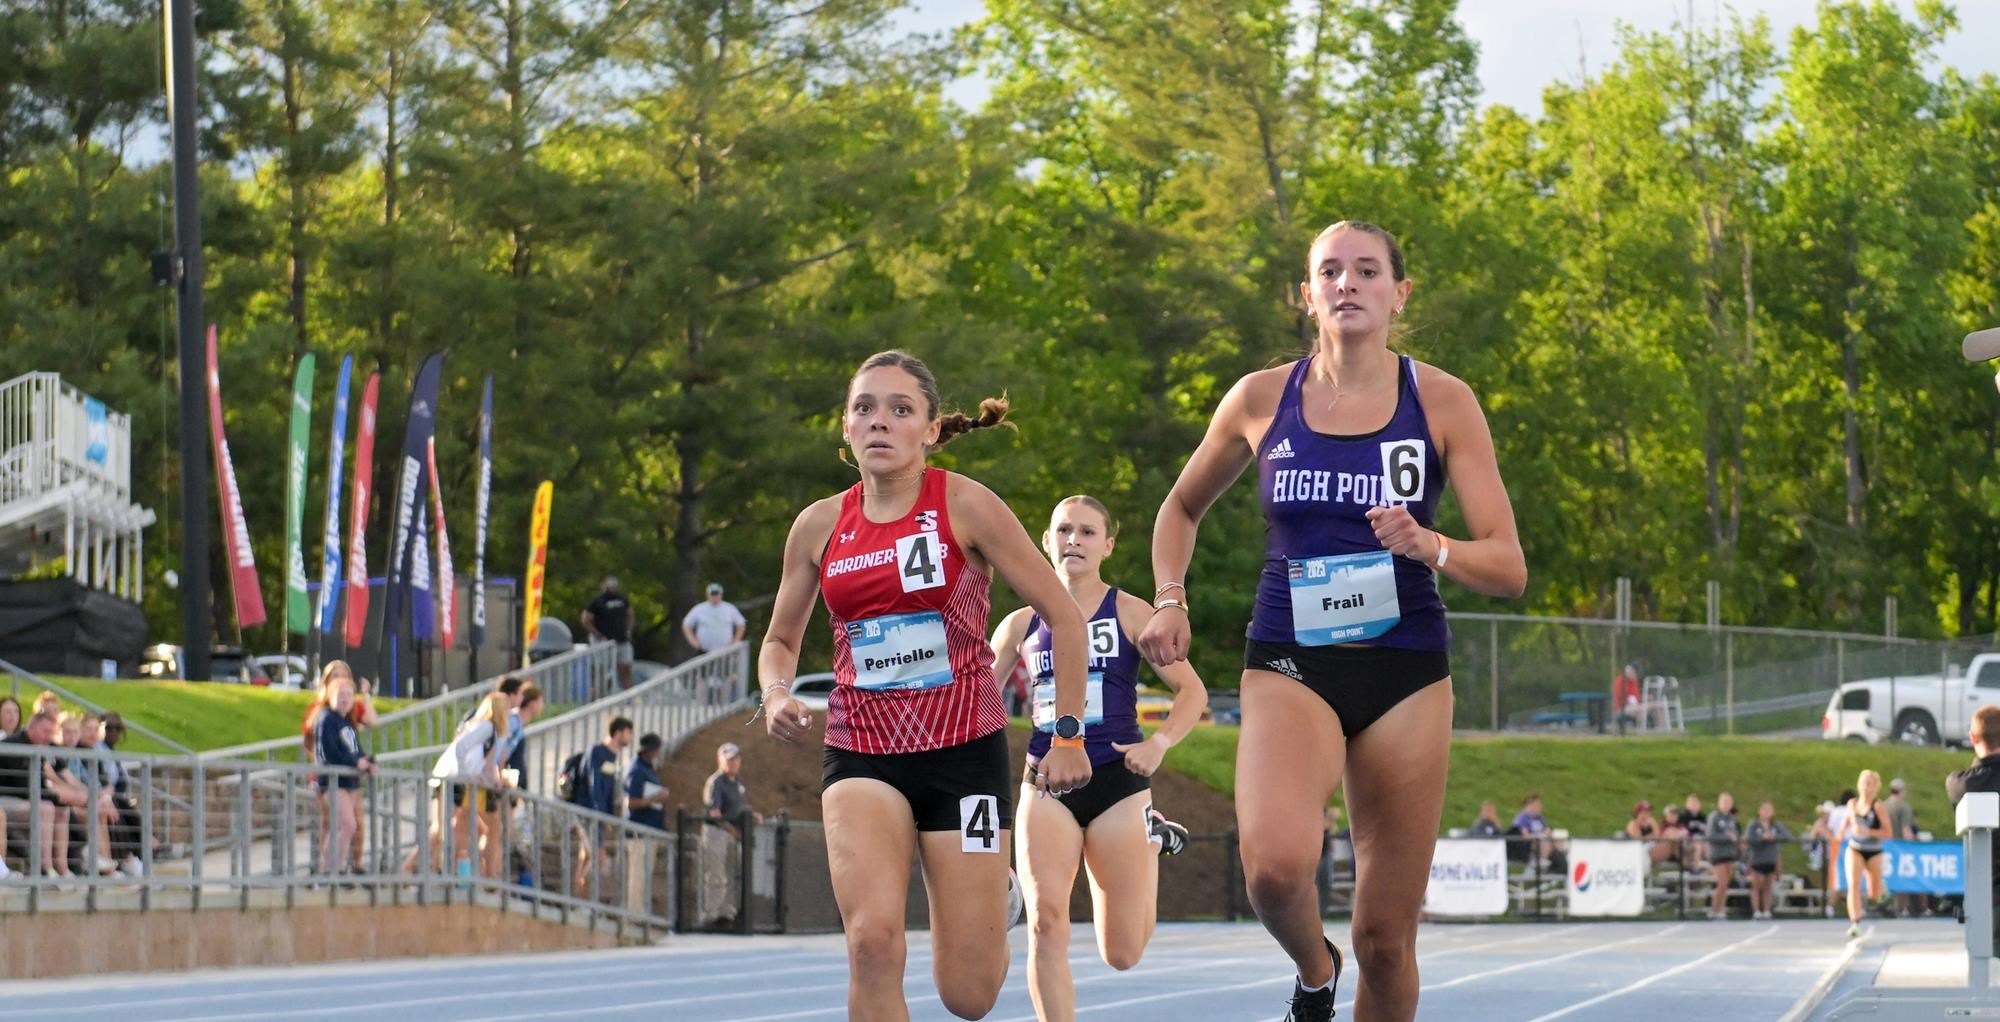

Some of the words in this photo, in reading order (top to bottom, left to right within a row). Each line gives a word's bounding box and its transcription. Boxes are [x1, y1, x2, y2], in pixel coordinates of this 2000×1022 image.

[1268, 451, 1295, 460] adidas
[1389, 445, 1420, 497] 6
[1272, 469, 1330, 503] HIGH
[827, 543, 948, 577] GARDNER-B
[904, 536, 936, 584] 4
[1306, 560, 1326, 578] 2025
[1322, 593, 1364, 611] Frail
[1092, 621, 1114, 654] 5
[1331, 629, 1346, 639] HIGH
[1347, 626, 1364, 637] POINT
[864, 648, 935, 671] Perriello
[966, 799, 994, 848] 4
[1898, 853, 1916, 877] IS
[1920, 853, 1958, 878] THE
